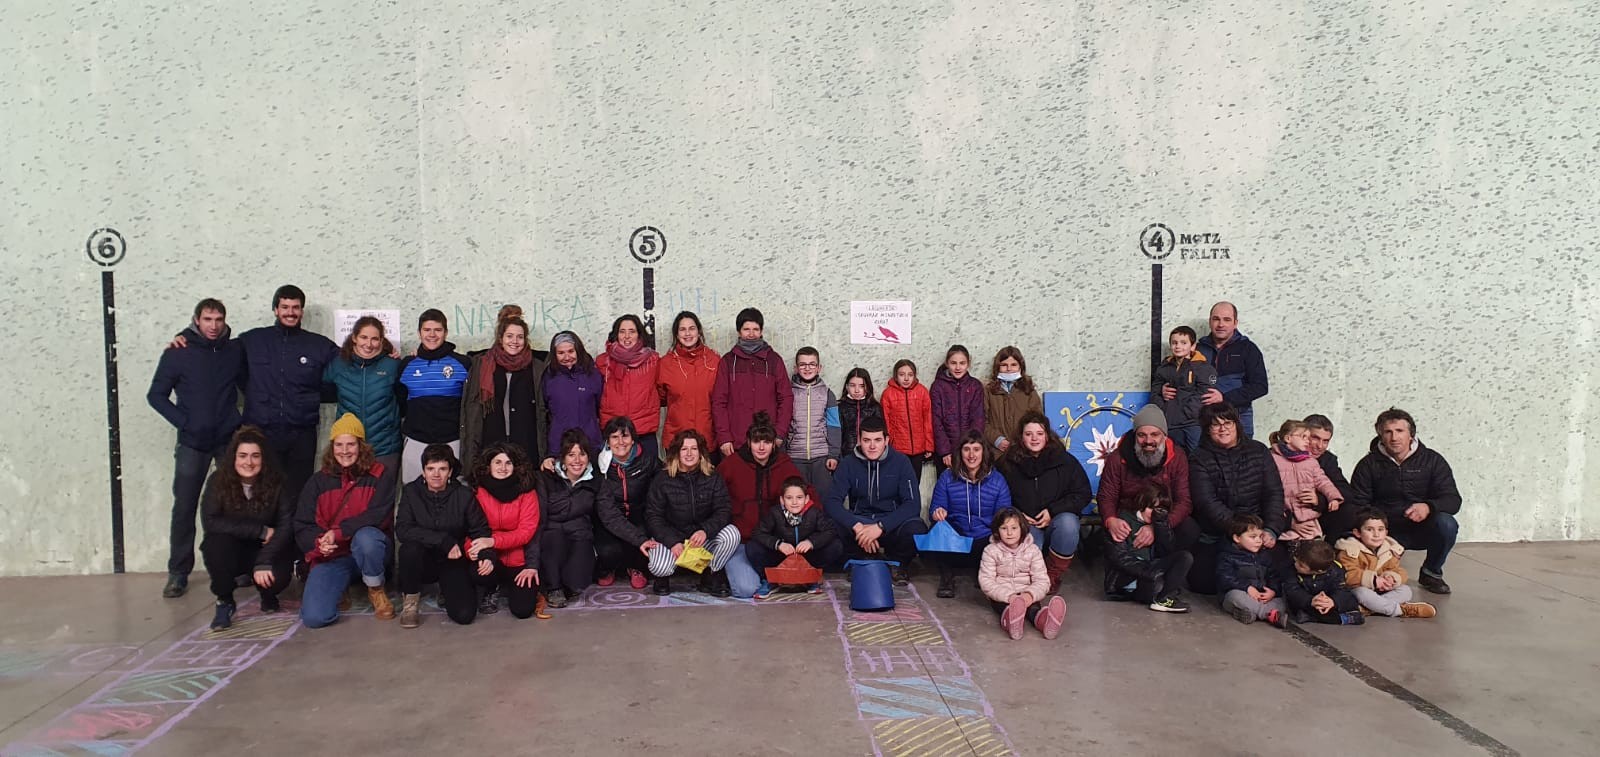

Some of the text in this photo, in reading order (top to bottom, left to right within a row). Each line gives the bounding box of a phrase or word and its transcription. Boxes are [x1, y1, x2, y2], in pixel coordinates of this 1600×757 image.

[98, 237, 116, 259] 6
[639, 235, 656, 256] 5
[1148, 231, 1164, 252] 4
[1180, 233, 1221, 245] MOTZ
[1180, 248, 1230, 260] FALTA
